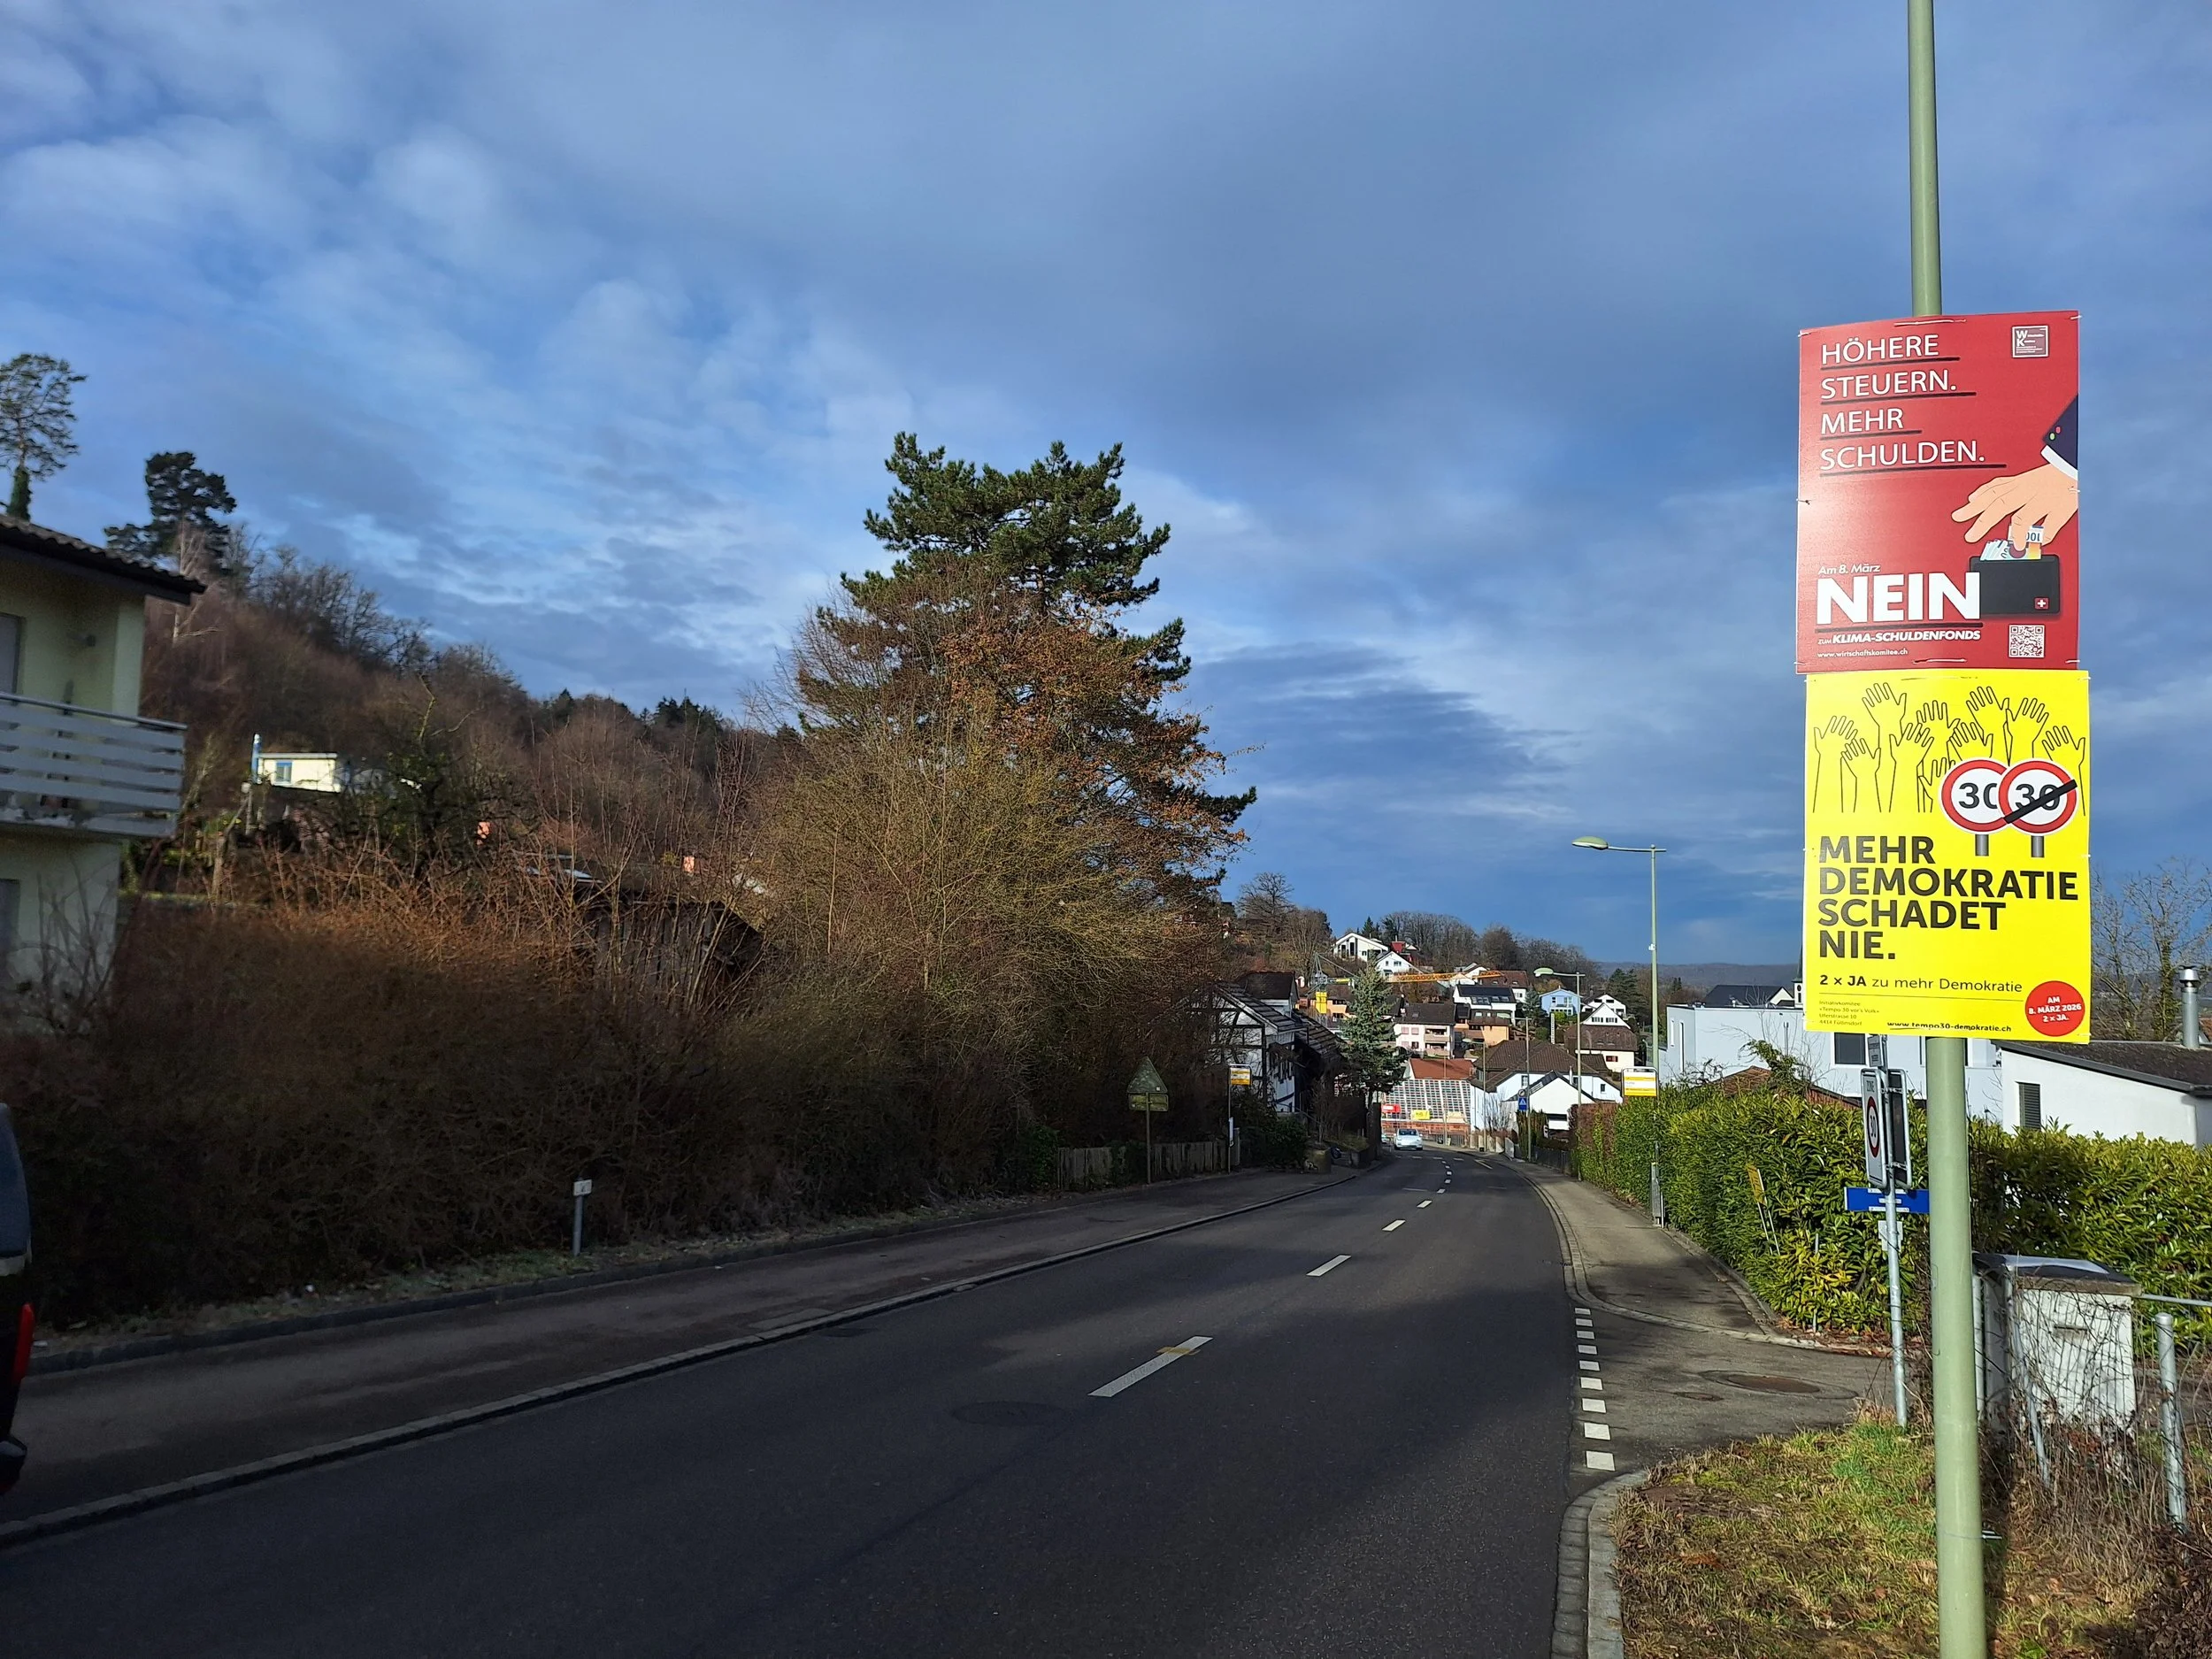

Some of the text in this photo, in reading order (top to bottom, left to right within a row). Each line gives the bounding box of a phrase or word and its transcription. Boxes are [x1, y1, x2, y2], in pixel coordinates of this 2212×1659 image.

[1821, 334, 1939, 365] HÖHERE
[1820, 369, 1957, 399] STEUERN.
[1821, 407, 1904, 434] MEHR
[1819, 440, 1985, 471] SCHULDEN.
[1818, 563, 1881, 575] Am 8. März
[1816, 572, 1980, 625] NEIN
[1832, 629, 1981, 644] KLIMA-SCHULDENFONDS
[1816, 648, 1909, 658] www.wirtschaftskomitee.ch
[1818, 835, 1936, 864] MEHR
[1818, 867, 2079, 901] DEMOKRATIE
[1817, 898, 2007, 931] SCHADET
[1819, 930, 1896, 960] NIE.
[1819, 974, 2023, 993] 2 x JA zu mehr Demokratie
[2038, 1004, 2061, 1014] MÄRZ
[1886, 1021, 2012, 1033] wwwtempo30-demokratie.ch
